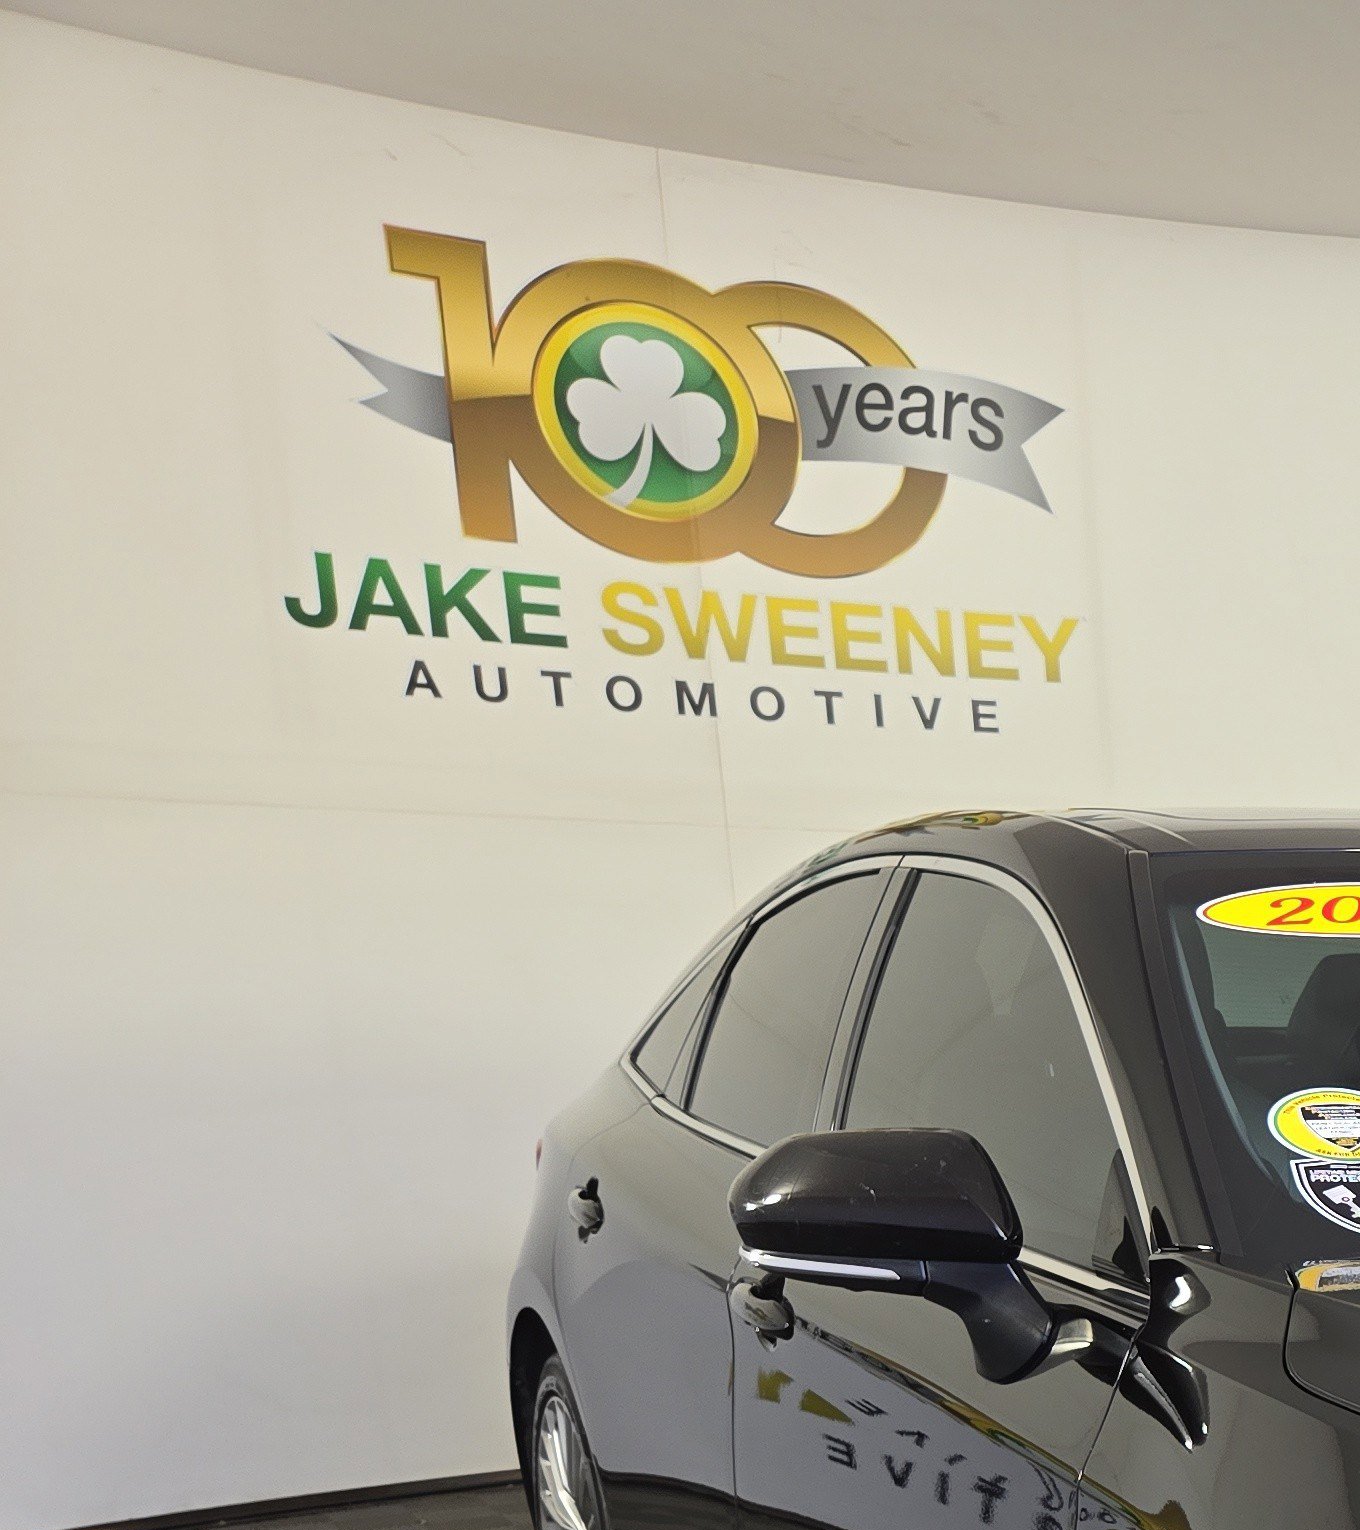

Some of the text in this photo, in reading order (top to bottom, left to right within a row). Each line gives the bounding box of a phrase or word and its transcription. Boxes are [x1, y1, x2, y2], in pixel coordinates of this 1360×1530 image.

[383, 223, 1006, 579] 100 years
[284, 550, 1081, 683] JAKE SWEENEY
[405, 659, 1001, 734] AUTOMOTIVE
